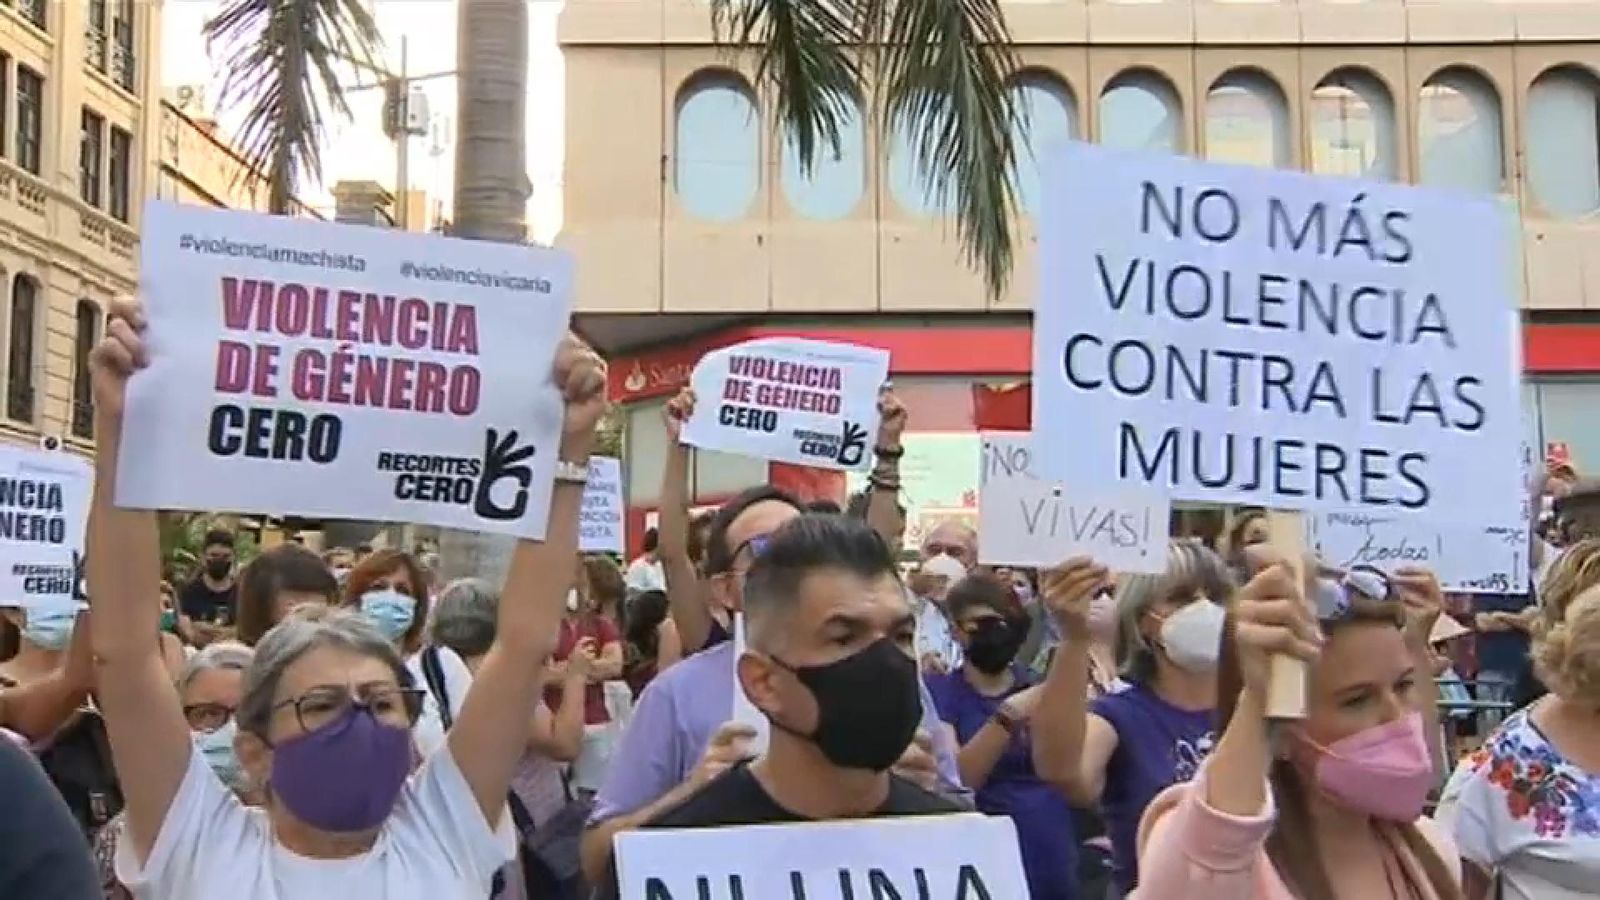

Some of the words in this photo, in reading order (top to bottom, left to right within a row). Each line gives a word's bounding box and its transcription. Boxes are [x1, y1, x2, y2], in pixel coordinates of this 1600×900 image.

[1141, 181, 1240, 244] NO
[1268, 193, 1412, 264] MÁS
[179, 234, 366, 273] #violenciamachista
[400, 262, 552, 294] #violenciavicaria
[221, 277, 480, 355] VIOLENCIA
[1095, 253, 1457, 349] VIOLENCIA
[215, 341, 280, 398] DE
[292, 342, 481, 416] GÉNERO
[723, 377, 752, 403] DE
[729, 355, 841, 391] VIOLENCIA
[1064, 333, 1346, 419] CONTRA
[1372, 366, 1485, 432] LAS
[208, 404, 342, 464] CERO
[719, 405, 778, 433] CERO
[378, 451, 480, 477] RECORTES
[1118, 422, 1431, 509] MUJERES
[395, 473, 473, 505] CERO
[24, 577, 70, 594] CERO
